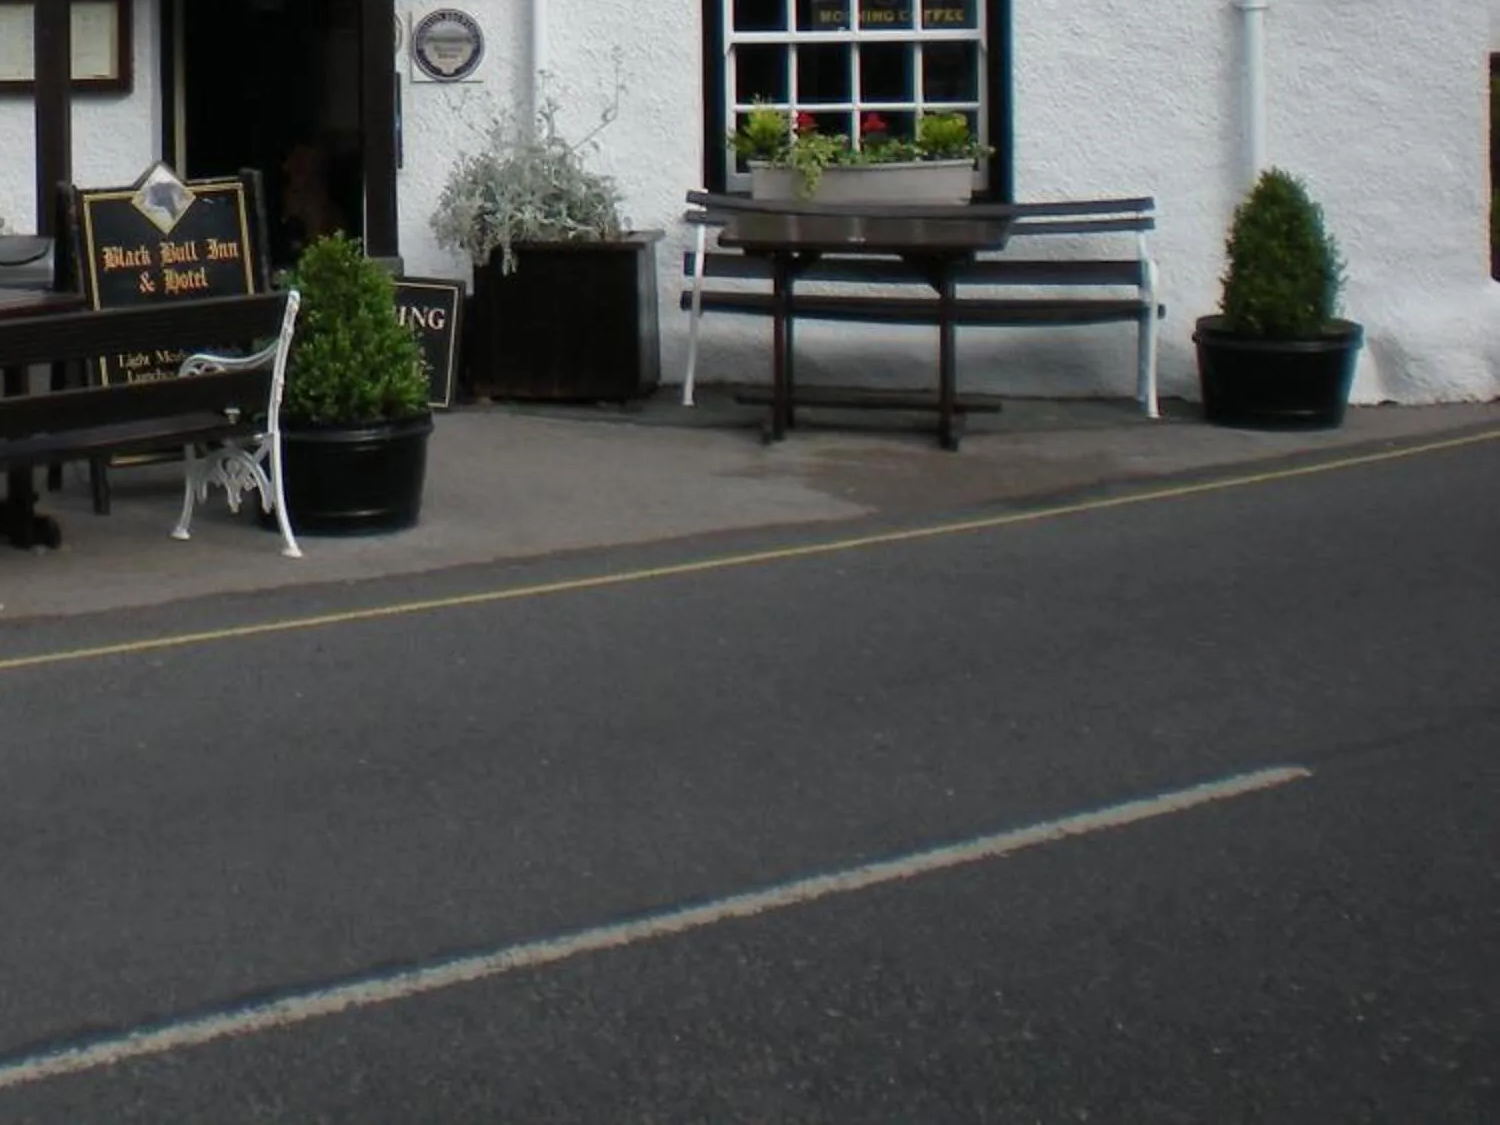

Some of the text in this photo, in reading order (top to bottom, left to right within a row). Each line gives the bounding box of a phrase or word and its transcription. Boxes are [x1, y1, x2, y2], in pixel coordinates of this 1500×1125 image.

[818, 8, 965, 23] MONING CFFEE
[101, 237, 239, 273] Black Bull Inn
[138, 266, 210, 296] & Hotel
